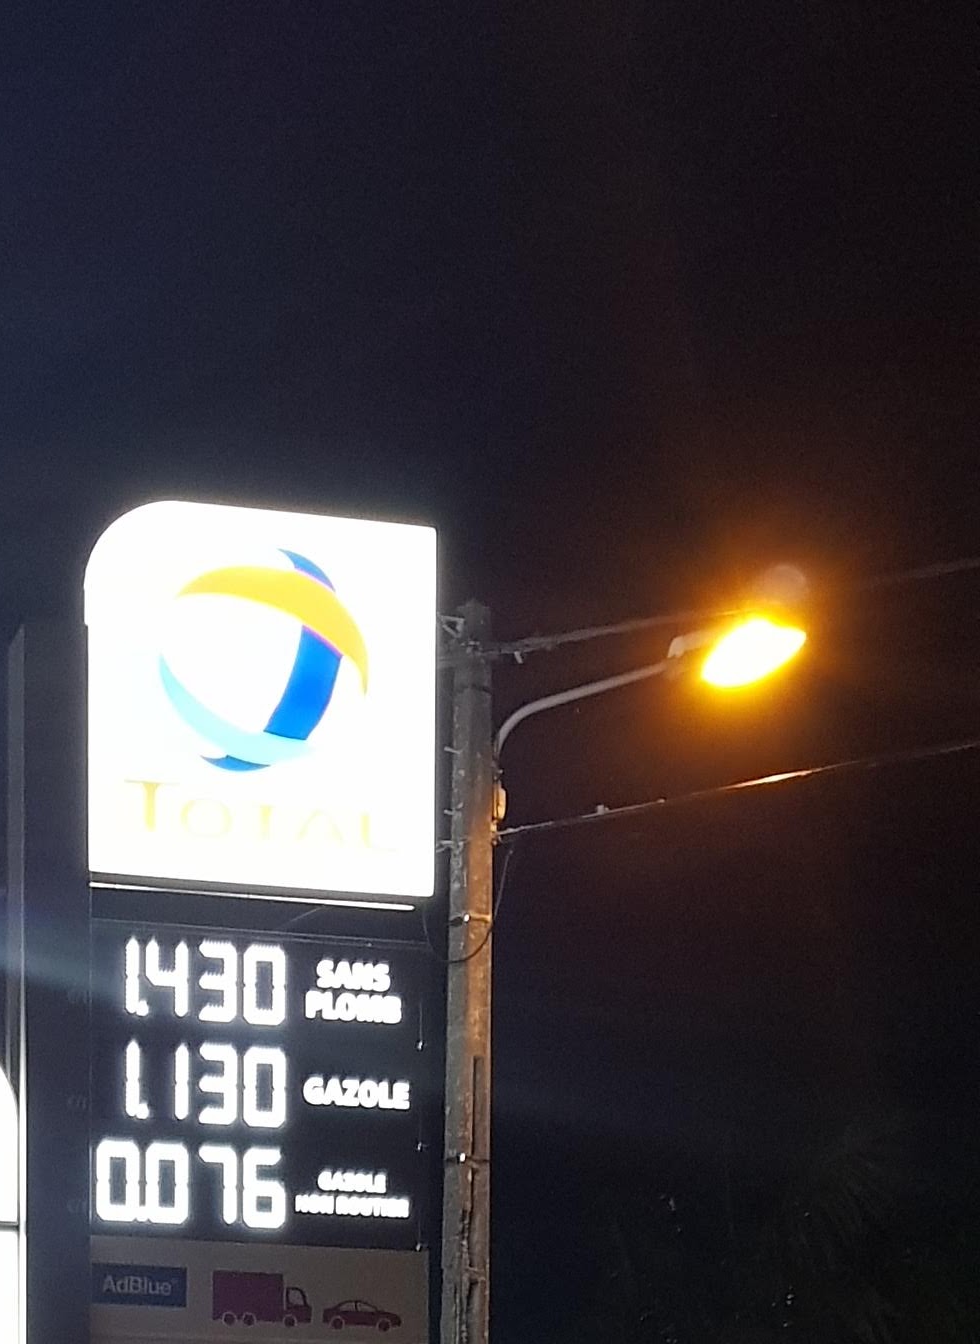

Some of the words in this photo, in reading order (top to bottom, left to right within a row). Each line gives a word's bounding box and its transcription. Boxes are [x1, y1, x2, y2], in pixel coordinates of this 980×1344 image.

[316, 959, 391, 992] SANS
[305, 990, 402, 1024] PLOMB
[303, 1077, 410, 1110] GAZOLE
[318, 1171, 386, 1194] GAZOLE
[102, 1273, 173, 1296] AdBlue
